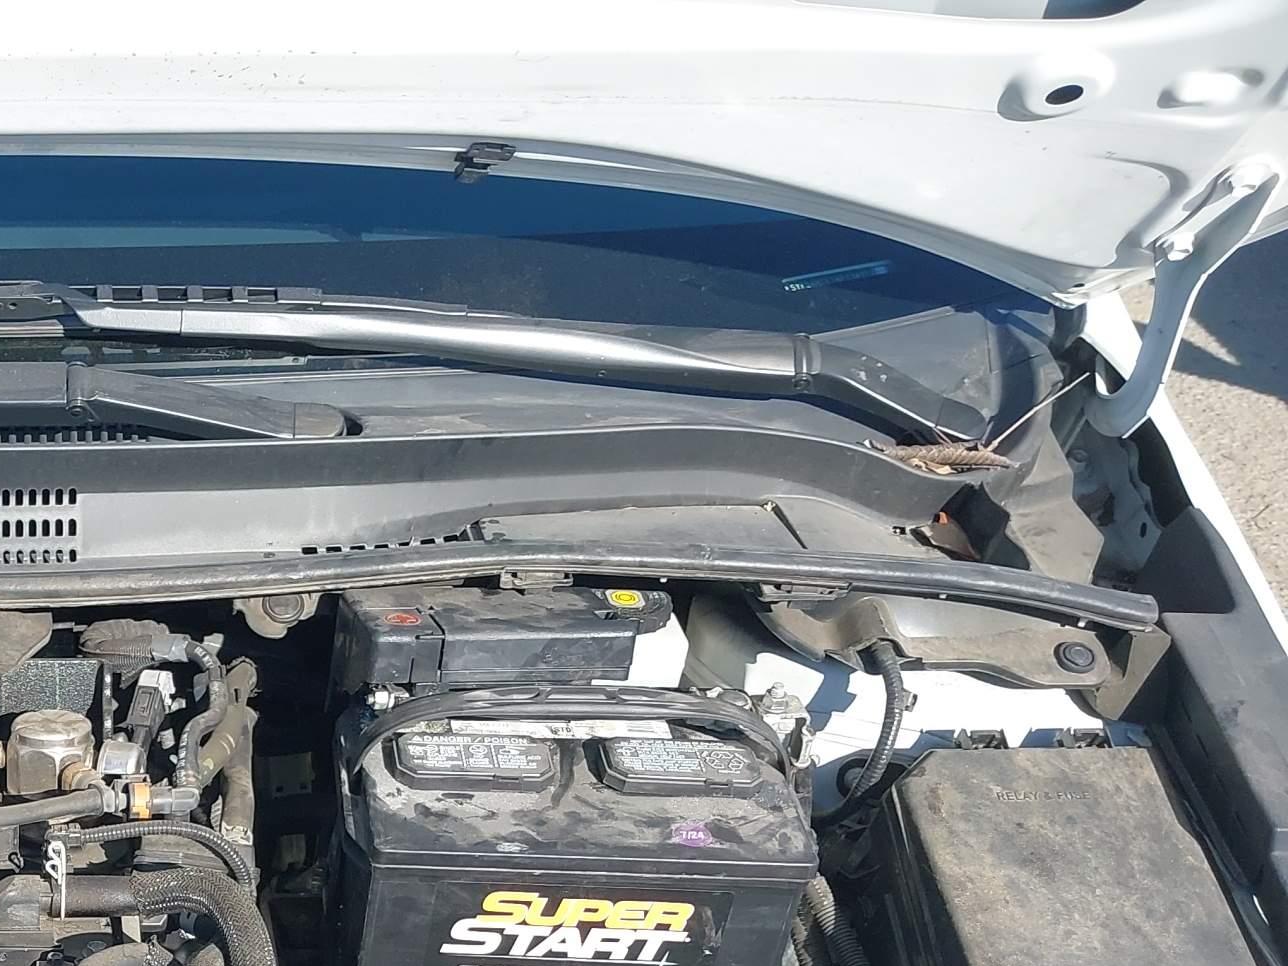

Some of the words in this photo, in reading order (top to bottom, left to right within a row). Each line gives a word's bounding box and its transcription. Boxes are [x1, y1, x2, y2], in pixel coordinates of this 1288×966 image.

[996, 791, 1039, 801] RELAY
[1057, 791, 1092, 800] FUSE
[477, 891, 695, 931] SUPER
[440, 918, 690, 961] START
